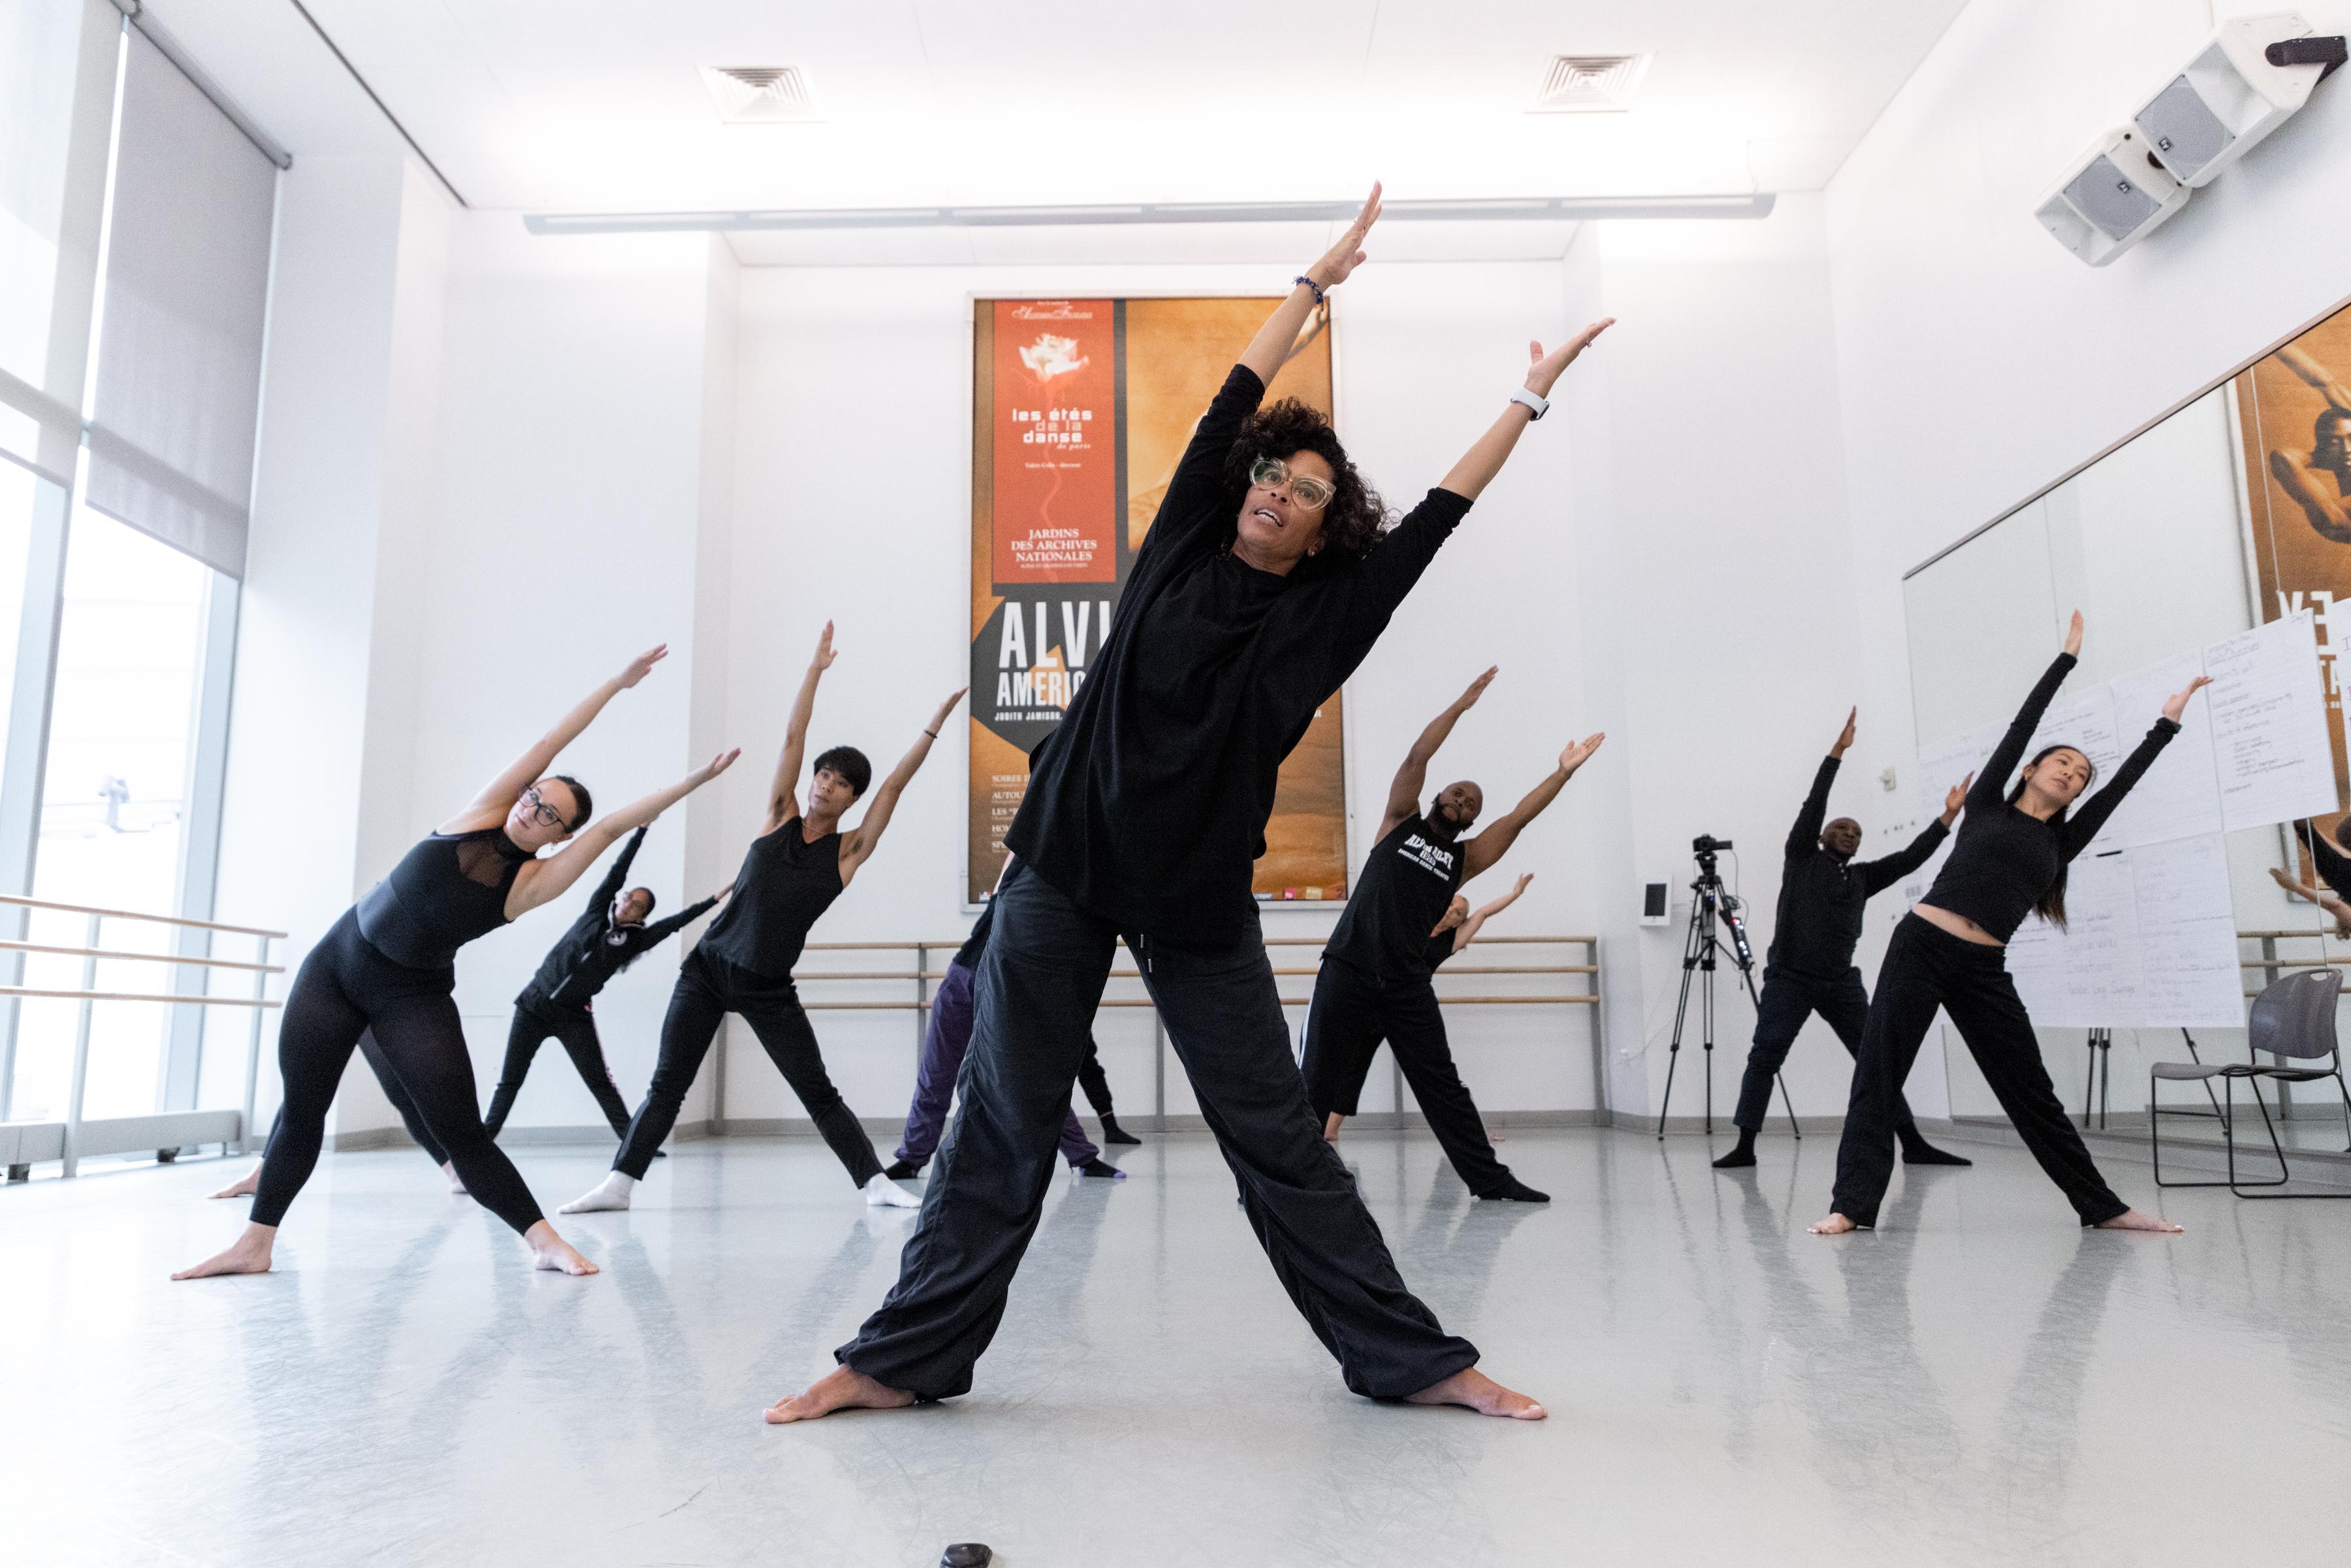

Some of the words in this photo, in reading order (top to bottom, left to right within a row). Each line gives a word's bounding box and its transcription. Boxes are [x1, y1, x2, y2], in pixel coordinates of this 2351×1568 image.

[1012, 408, 1042, 422] les
[1049, 408, 1093, 421] étés
[1035, 419, 1058, 432] de
[1065, 419, 1082, 432] la
[1023, 430, 1082, 443] danse
[1029, 528, 1080, 541] JARDINS
[1010, 540, 1034, 551] DES
[1036, 539, 1097, 550] ARCHIVES
[1016, 551, 1093, 562] NATIONALES
[999, 601, 1111, 668] ALVI
[996, 671, 1087, 707] AMERIC
[995, 712, 1023, 721] JUDITH
[1404, 833, 1433, 853] ALVIN
[1431, 846, 1454, 871] AILEY
[1398, 848, 1420, 862] AMERICAN
[1418, 859, 1433, 871] DANCE
[1433, 868, 1449, 881] THEATER
